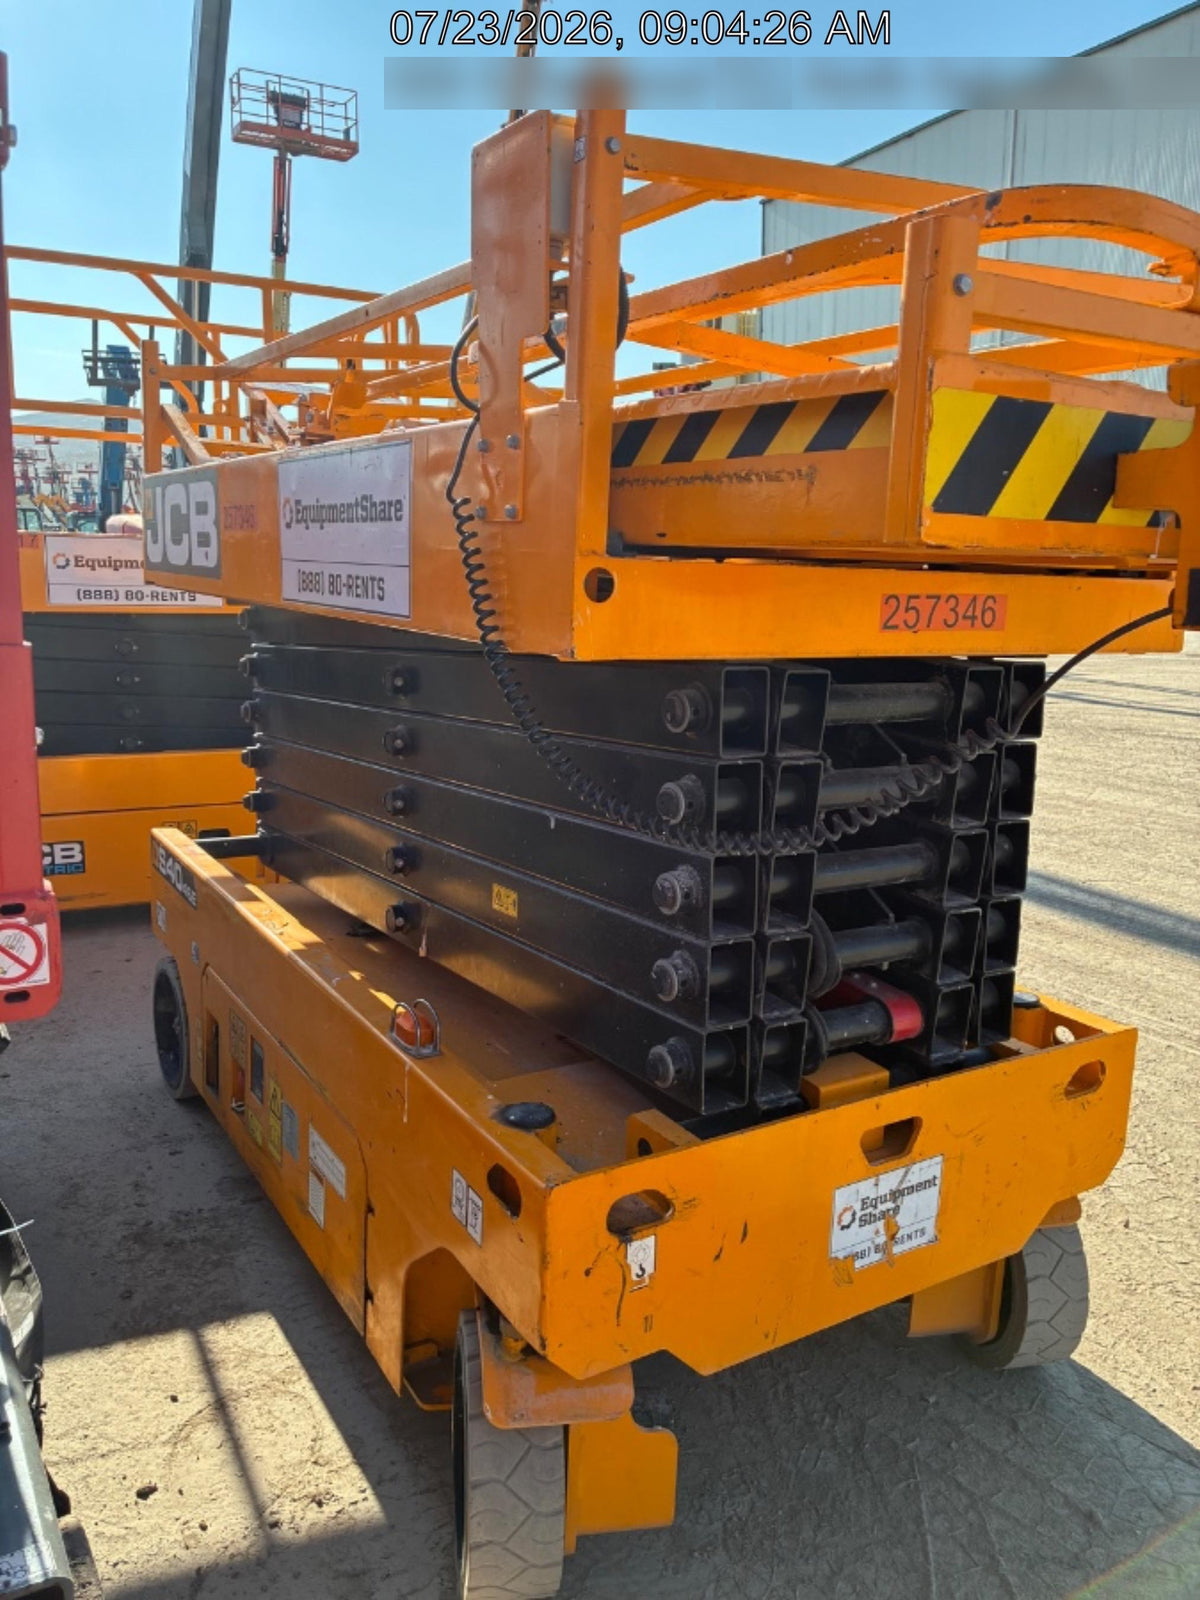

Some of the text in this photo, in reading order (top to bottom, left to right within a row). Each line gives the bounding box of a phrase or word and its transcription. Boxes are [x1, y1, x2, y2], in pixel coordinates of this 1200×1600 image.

[145, 481, 218, 568] JCB
[294, 494, 404, 530] EquipmentShare
[76, 588, 119, 602] (888)
[297, 568, 385, 601] (888) 80-RENTS
[881, 594, 997, 630] 257346
[860, 1175, 938, 1212] Equipment
[858, 1204, 900, 1228] Share
